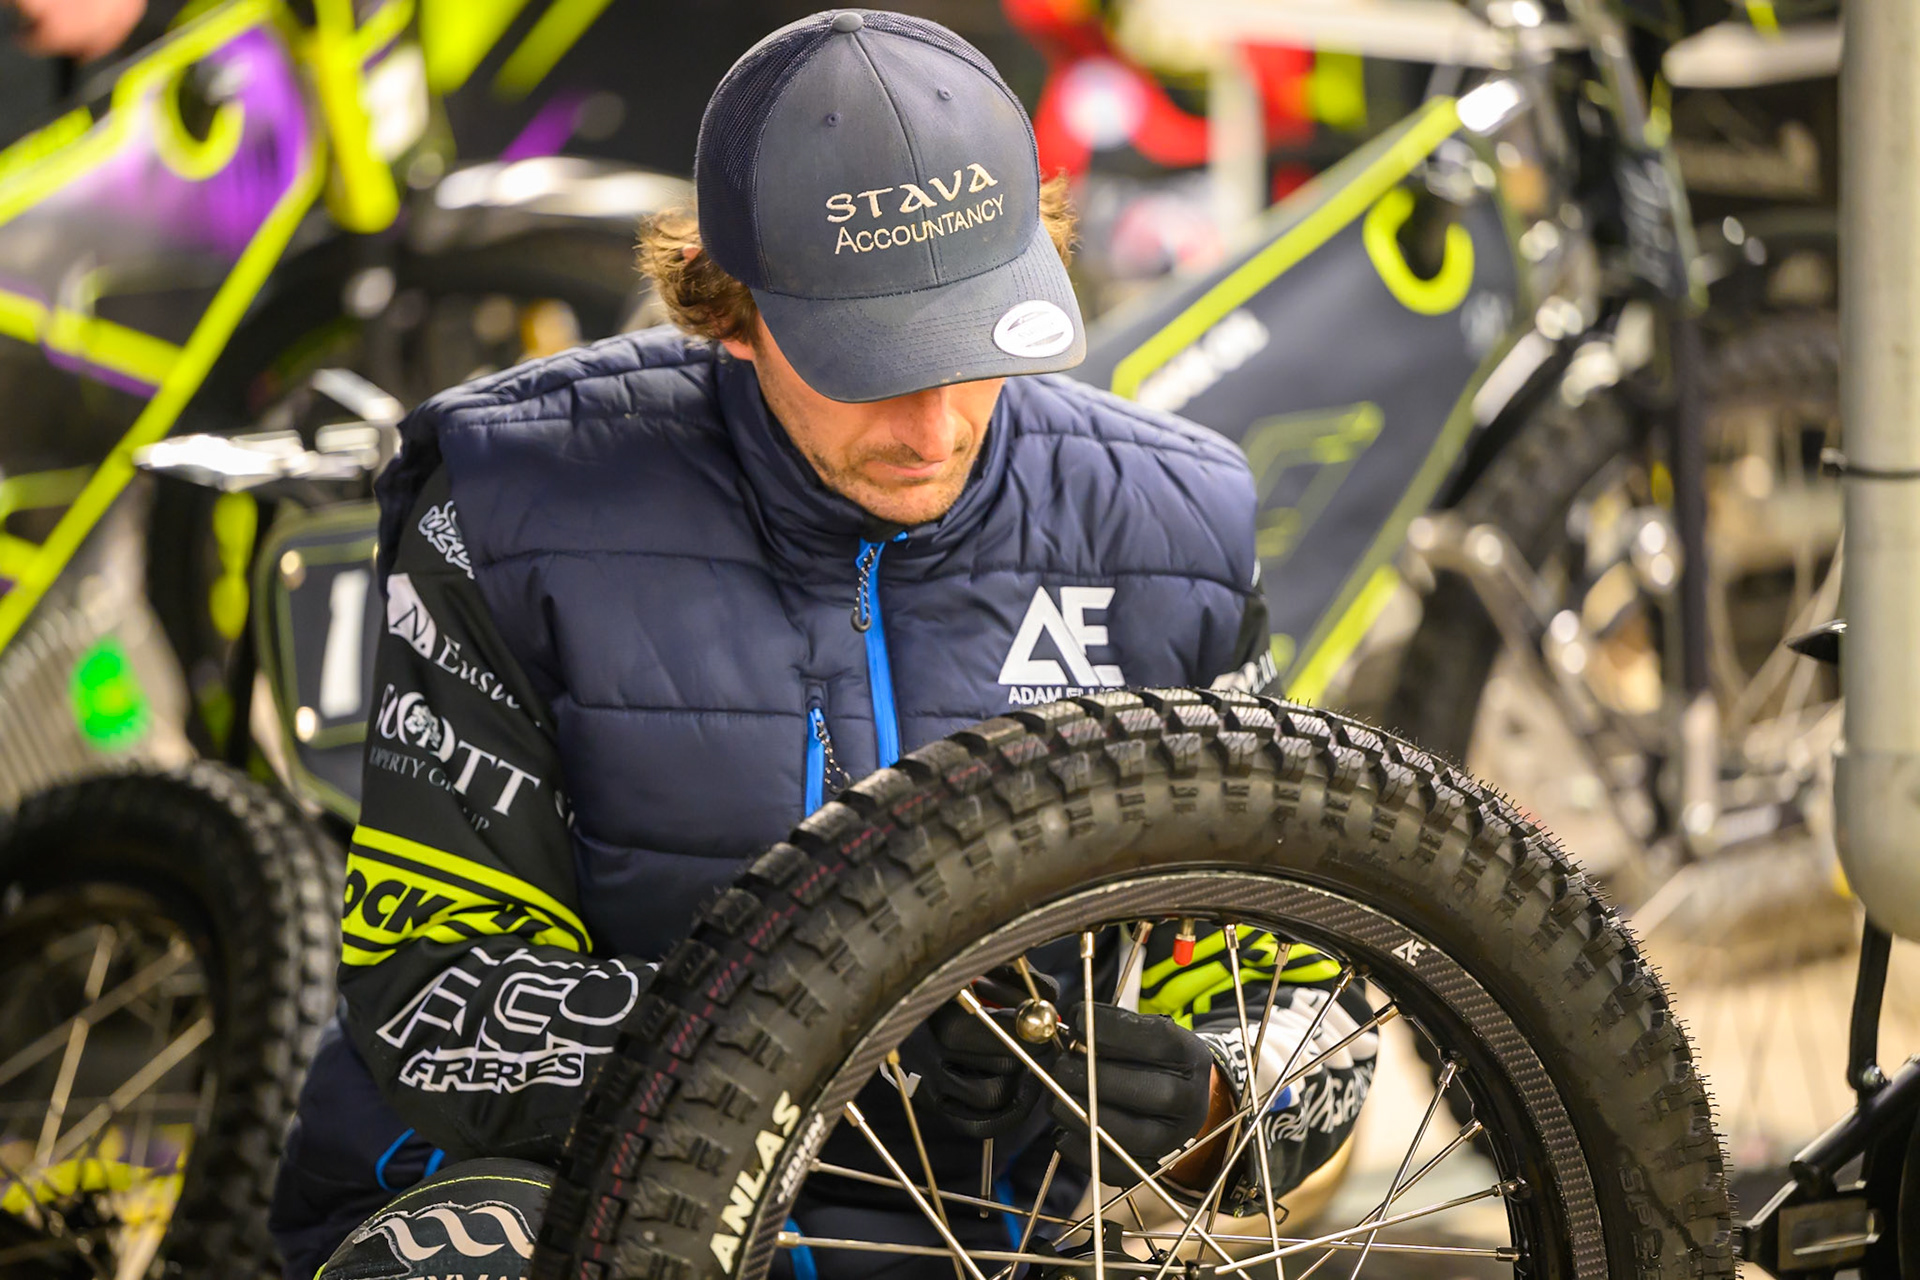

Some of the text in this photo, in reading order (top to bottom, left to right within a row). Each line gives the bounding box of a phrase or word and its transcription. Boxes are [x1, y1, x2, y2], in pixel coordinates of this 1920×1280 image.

[826, 162, 998, 223] STAVA
[997, 585, 1126, 687] AE
[1008, 686, 1063, 705] ADAM
[401, 1050, 584, 1090] FRERES
[709, 1090, 801, 1275] ANLAS
